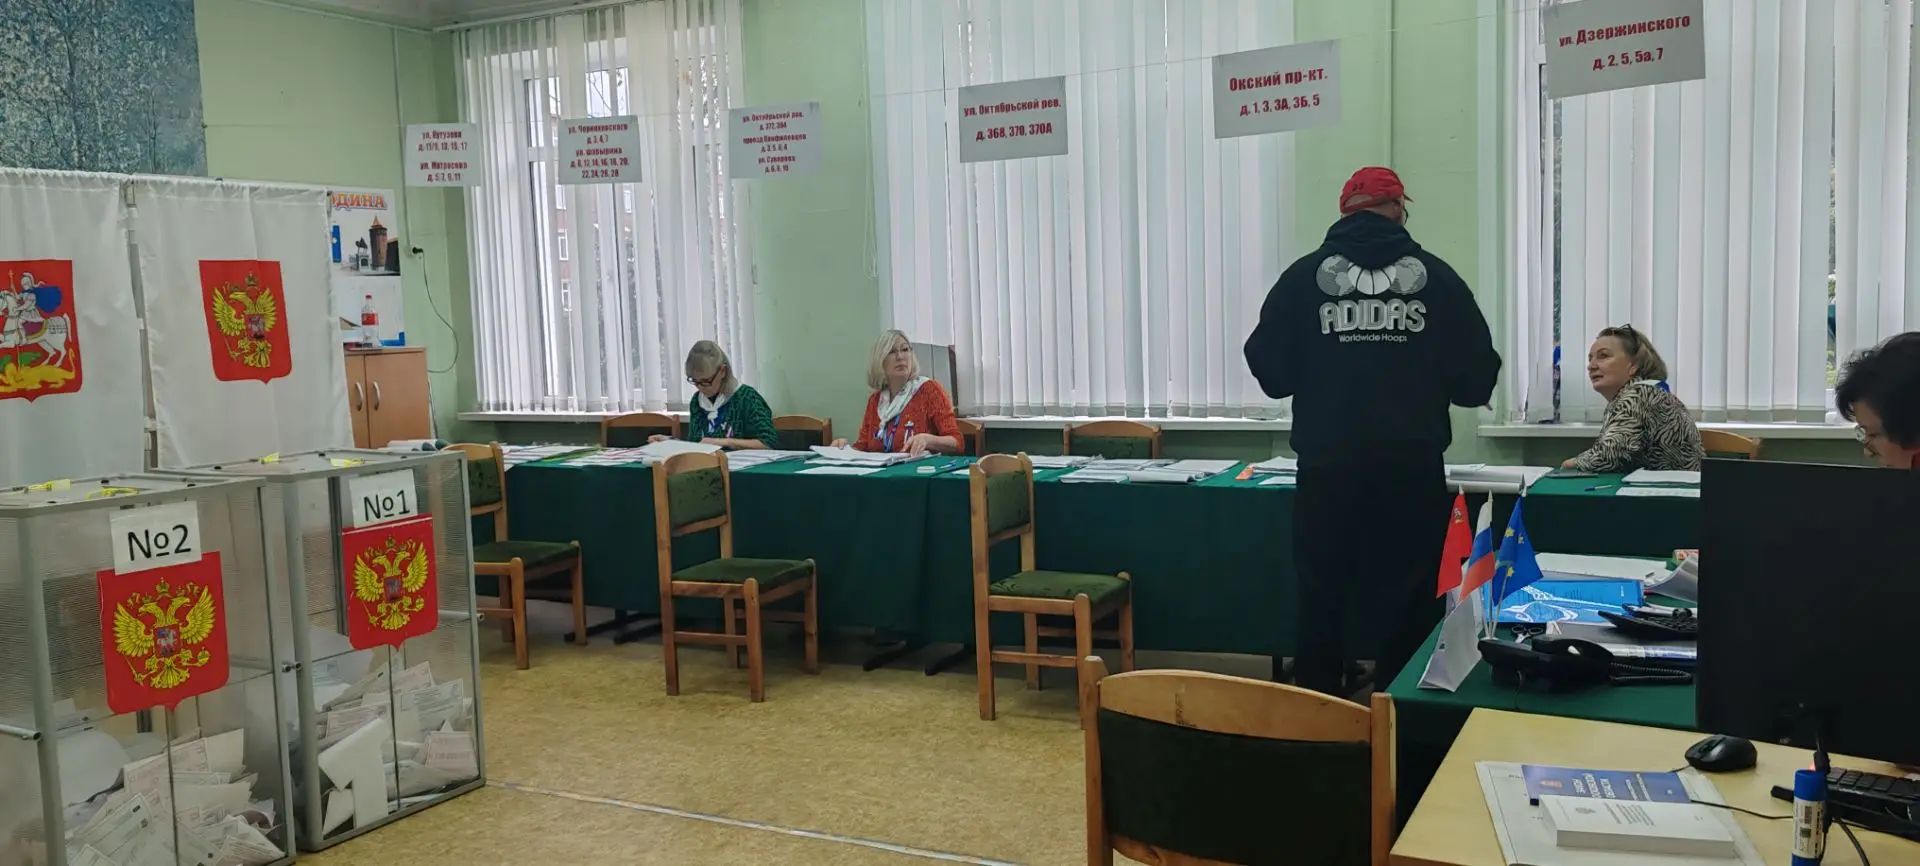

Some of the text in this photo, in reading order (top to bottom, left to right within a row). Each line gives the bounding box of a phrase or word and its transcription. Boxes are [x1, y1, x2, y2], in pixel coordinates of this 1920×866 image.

[1559, 16, 1690, 47] ул. Дзержинского
[1593, 48, 1663, 70] д. 2, 5, 5а, 7
[1230, 68, 1327, 91] Окский пр-кт.
[964, 98, 1061, 117] ул. Октябрьской рев.
[1240, 94, 1320, 116] д. 1, 3, 3А, 3Б, 5
[1009, 125, 1027, 137] 370,
[1029, 123, 1052, 135] 370А
[1319, 299, 1426, 334] ADIDAS
[1339, 334, 1407, 343] Worldwide Hoops
[364, 490, 410, 521] №1
[127, 524, 191, 561] №2
